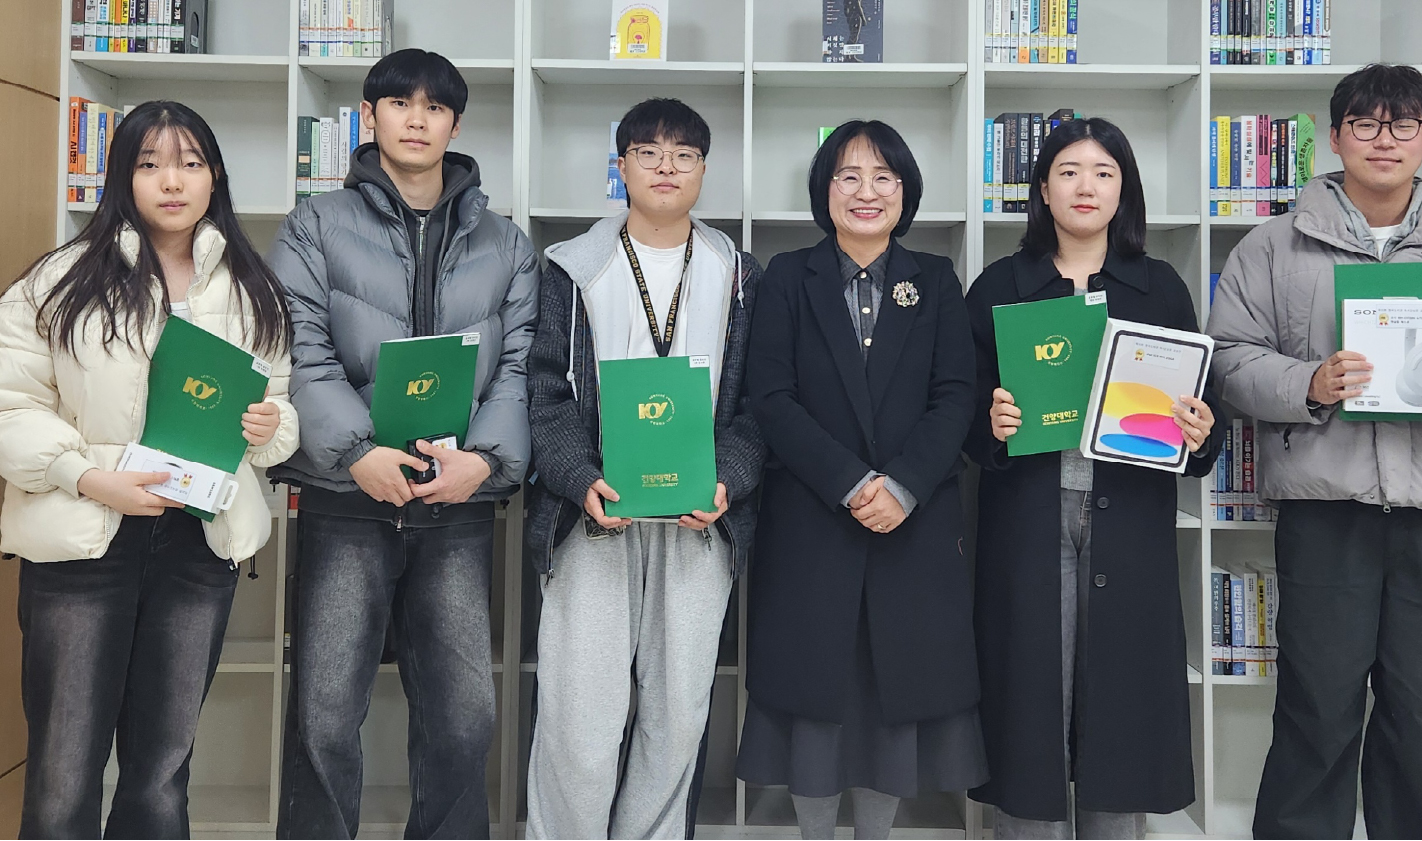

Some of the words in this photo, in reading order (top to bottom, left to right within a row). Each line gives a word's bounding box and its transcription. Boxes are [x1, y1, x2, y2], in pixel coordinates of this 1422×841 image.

[635, 268, 647, 293] STATE
[643, 294, 660, 338] UNIVERSITY
[1042, 410, 1079, 422] 건양대학교
